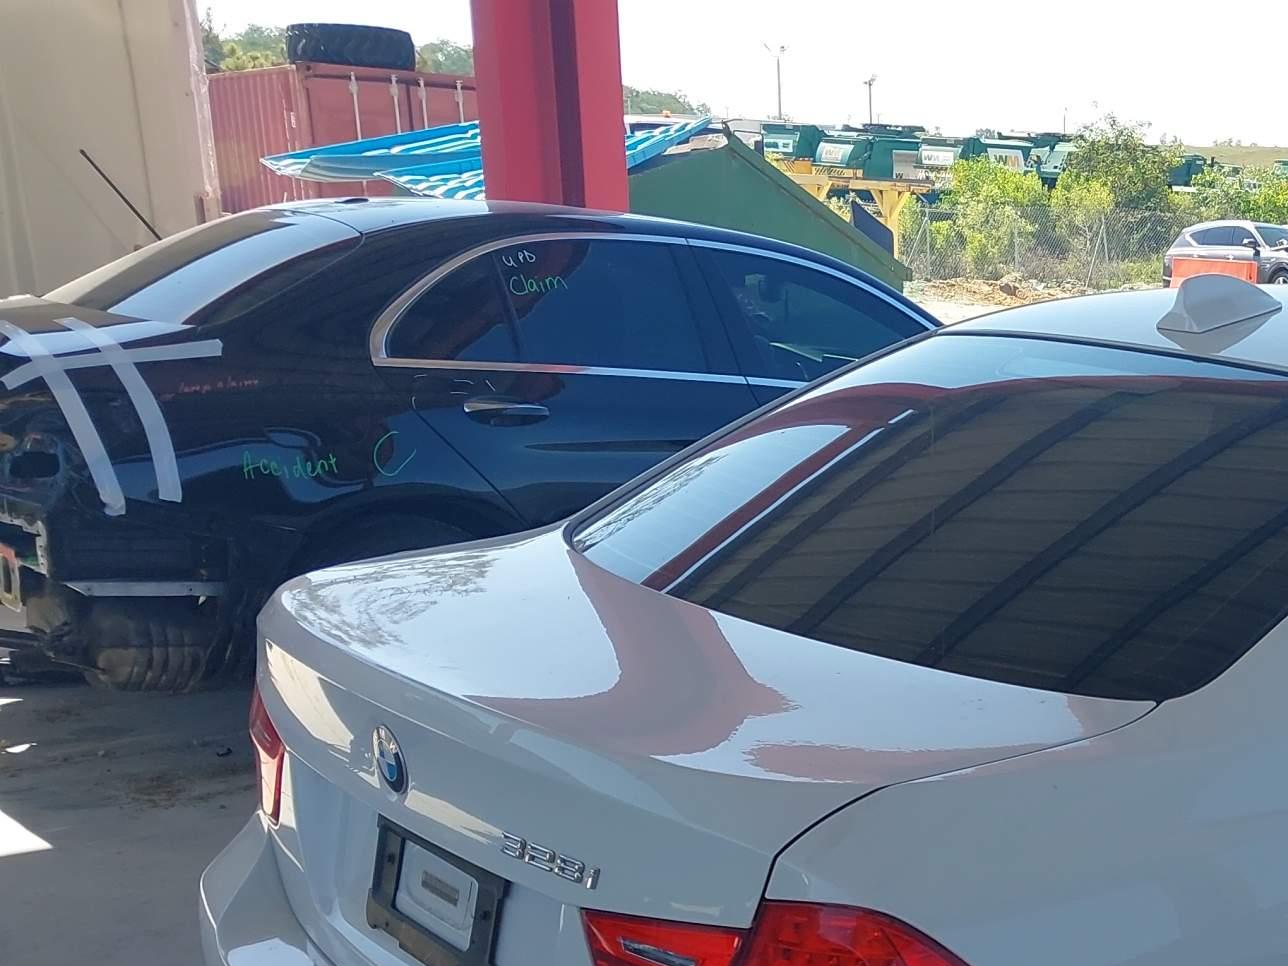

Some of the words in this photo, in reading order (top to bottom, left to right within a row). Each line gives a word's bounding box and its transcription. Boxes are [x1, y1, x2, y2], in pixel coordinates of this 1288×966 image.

[509, 273, 569, 296] Claim
[242, 451, 339, 480] Accident
[501, 830, 601, 890] 328i
